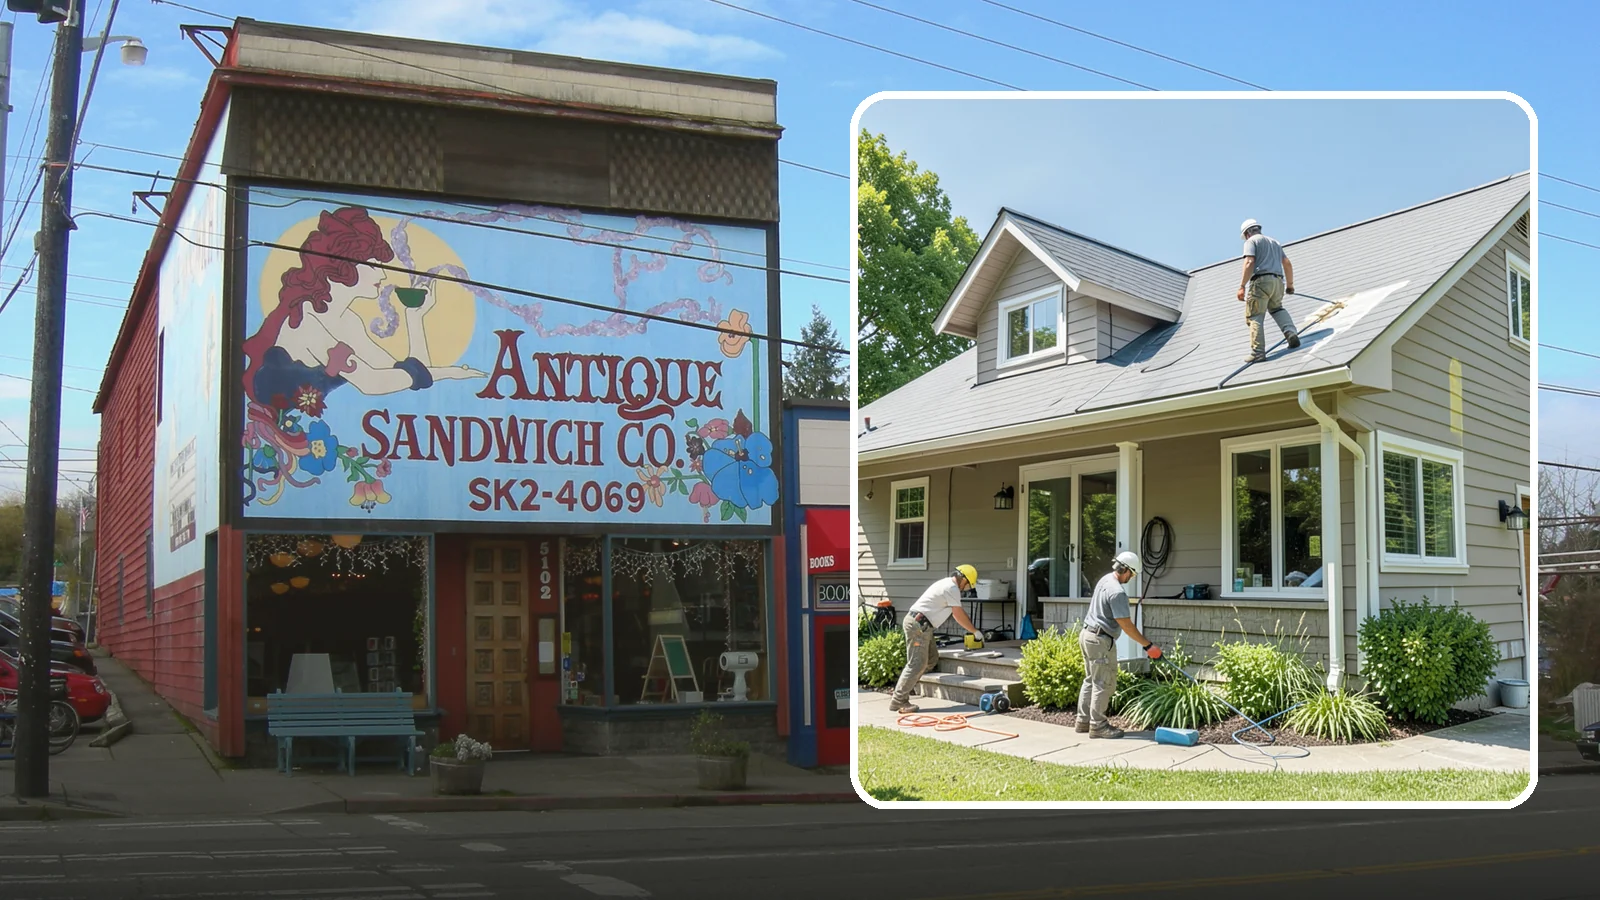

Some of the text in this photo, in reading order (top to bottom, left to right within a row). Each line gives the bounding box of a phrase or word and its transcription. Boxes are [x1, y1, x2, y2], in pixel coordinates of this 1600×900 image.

[476, 329, 723, 420] ANTIQUE
[361, 409, 685, 468] SANDWICH CO.
[469, 478, 645, 513] SK2-4069
[540, 542, 551, 600] 5102
[809, 555, 835, 569] BOOKS
